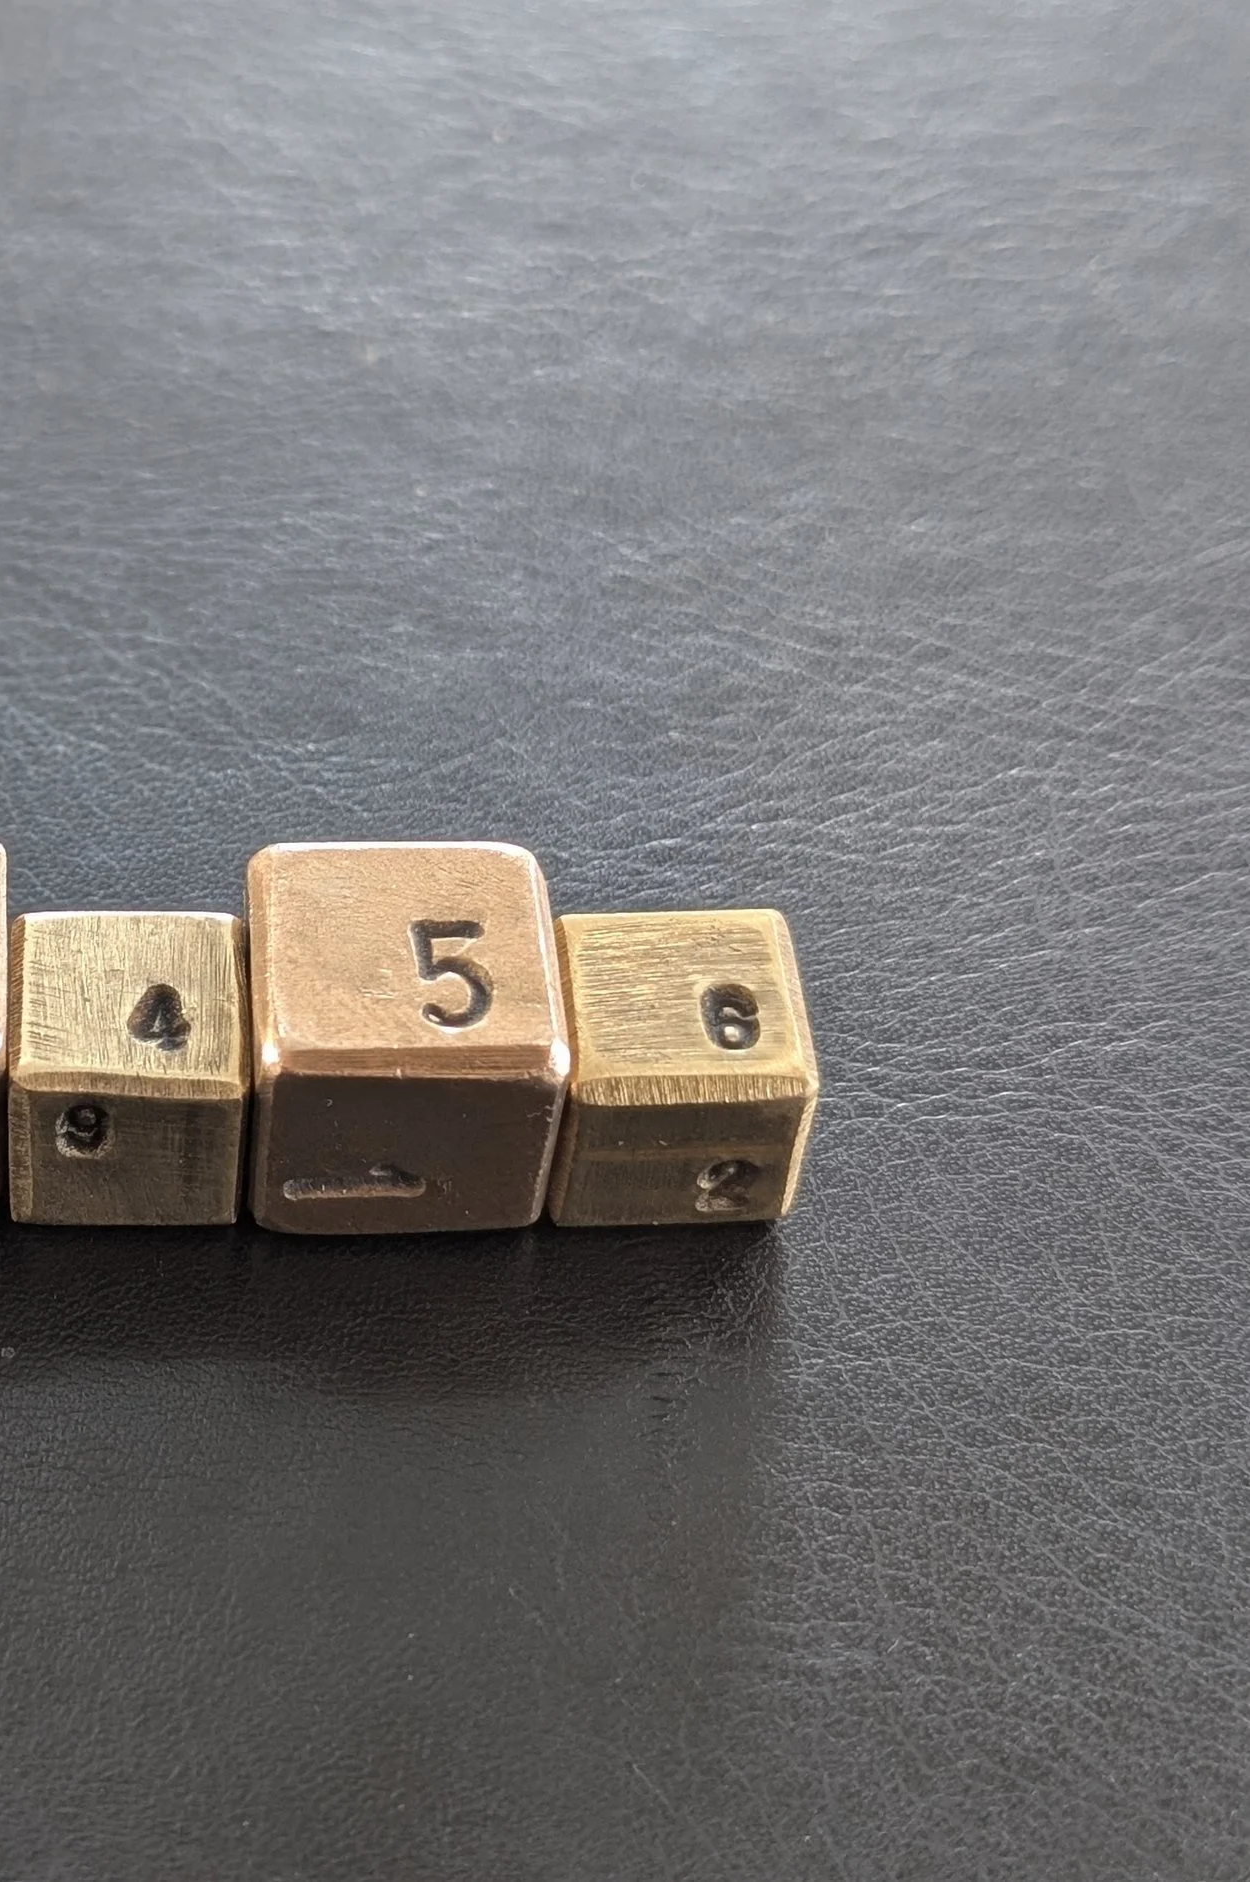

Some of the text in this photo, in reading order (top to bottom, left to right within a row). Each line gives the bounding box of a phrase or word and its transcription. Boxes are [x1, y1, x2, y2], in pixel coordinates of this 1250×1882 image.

[410, 919, 493, 1028] 5
[127, 983, 191, 1051] 4
[701, 983, 761, 1050] 6
[696, 1159, 762, 1213] 2
